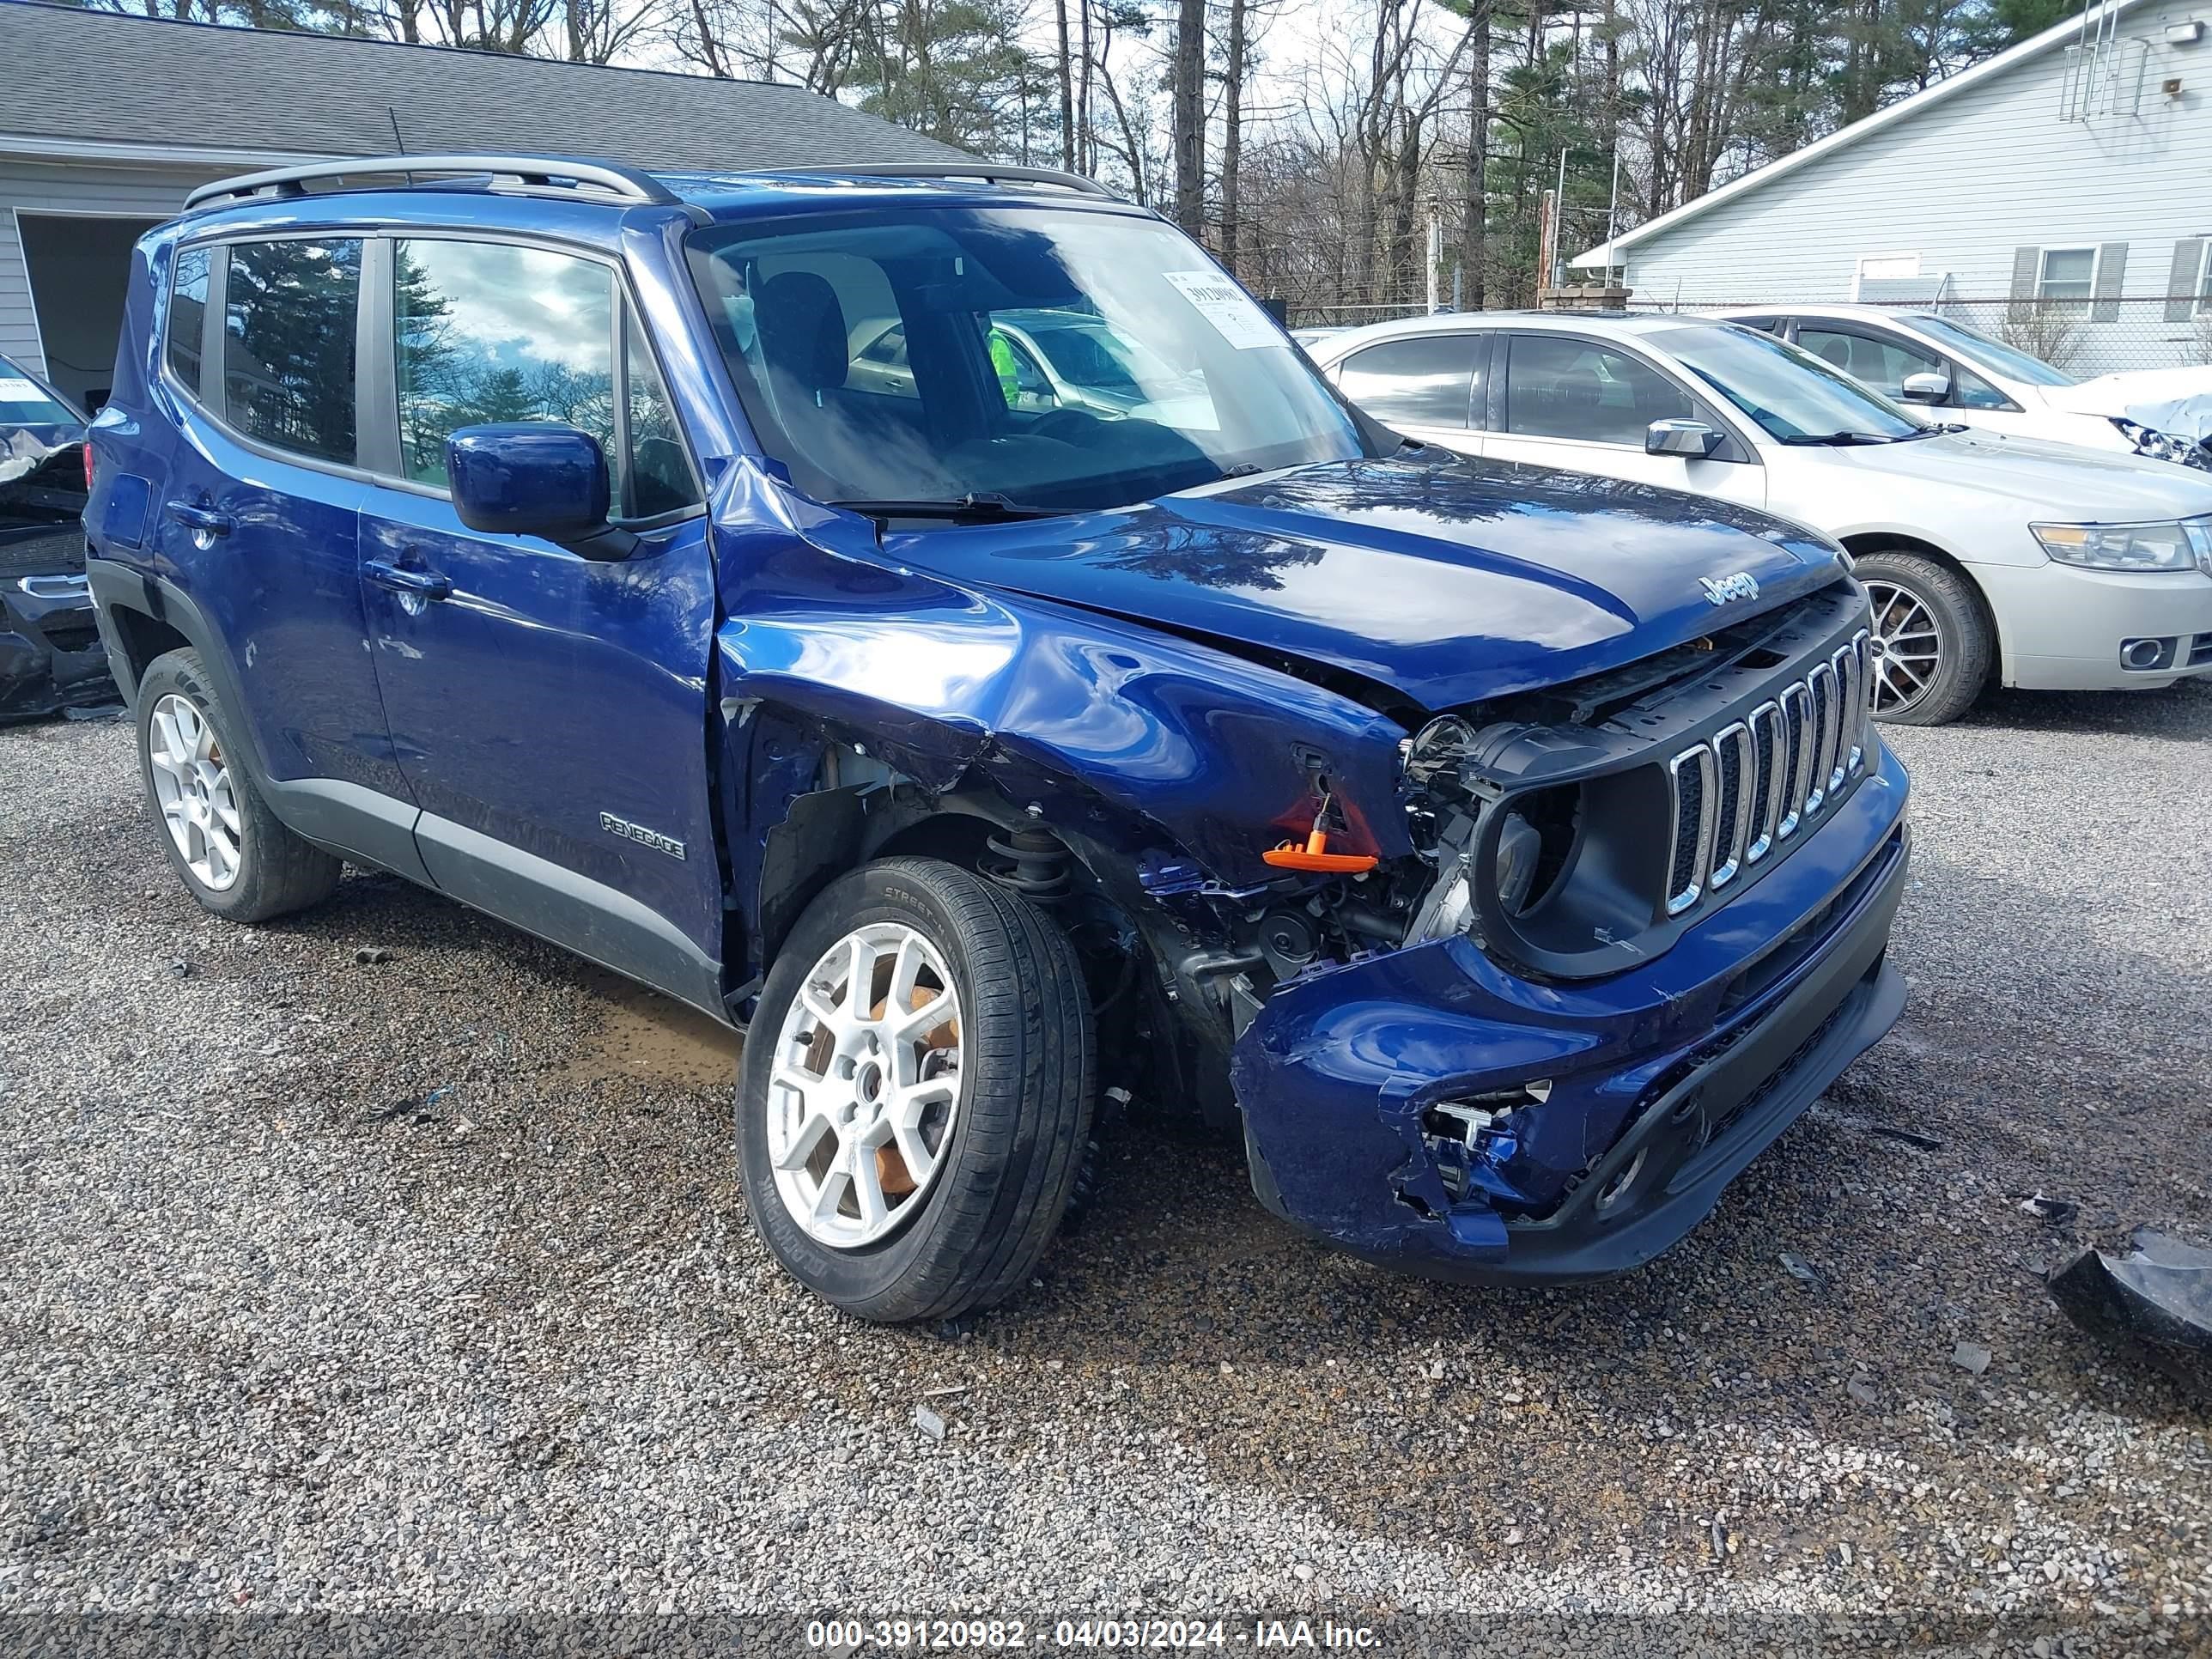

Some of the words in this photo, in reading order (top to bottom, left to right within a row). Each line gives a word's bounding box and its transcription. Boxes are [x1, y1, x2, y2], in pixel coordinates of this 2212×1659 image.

[1187, 287, 1243, 301] 39120982
[1698, 571, 1759, 606] Jeep
[599, 811, 687, 860] RENEGADE
